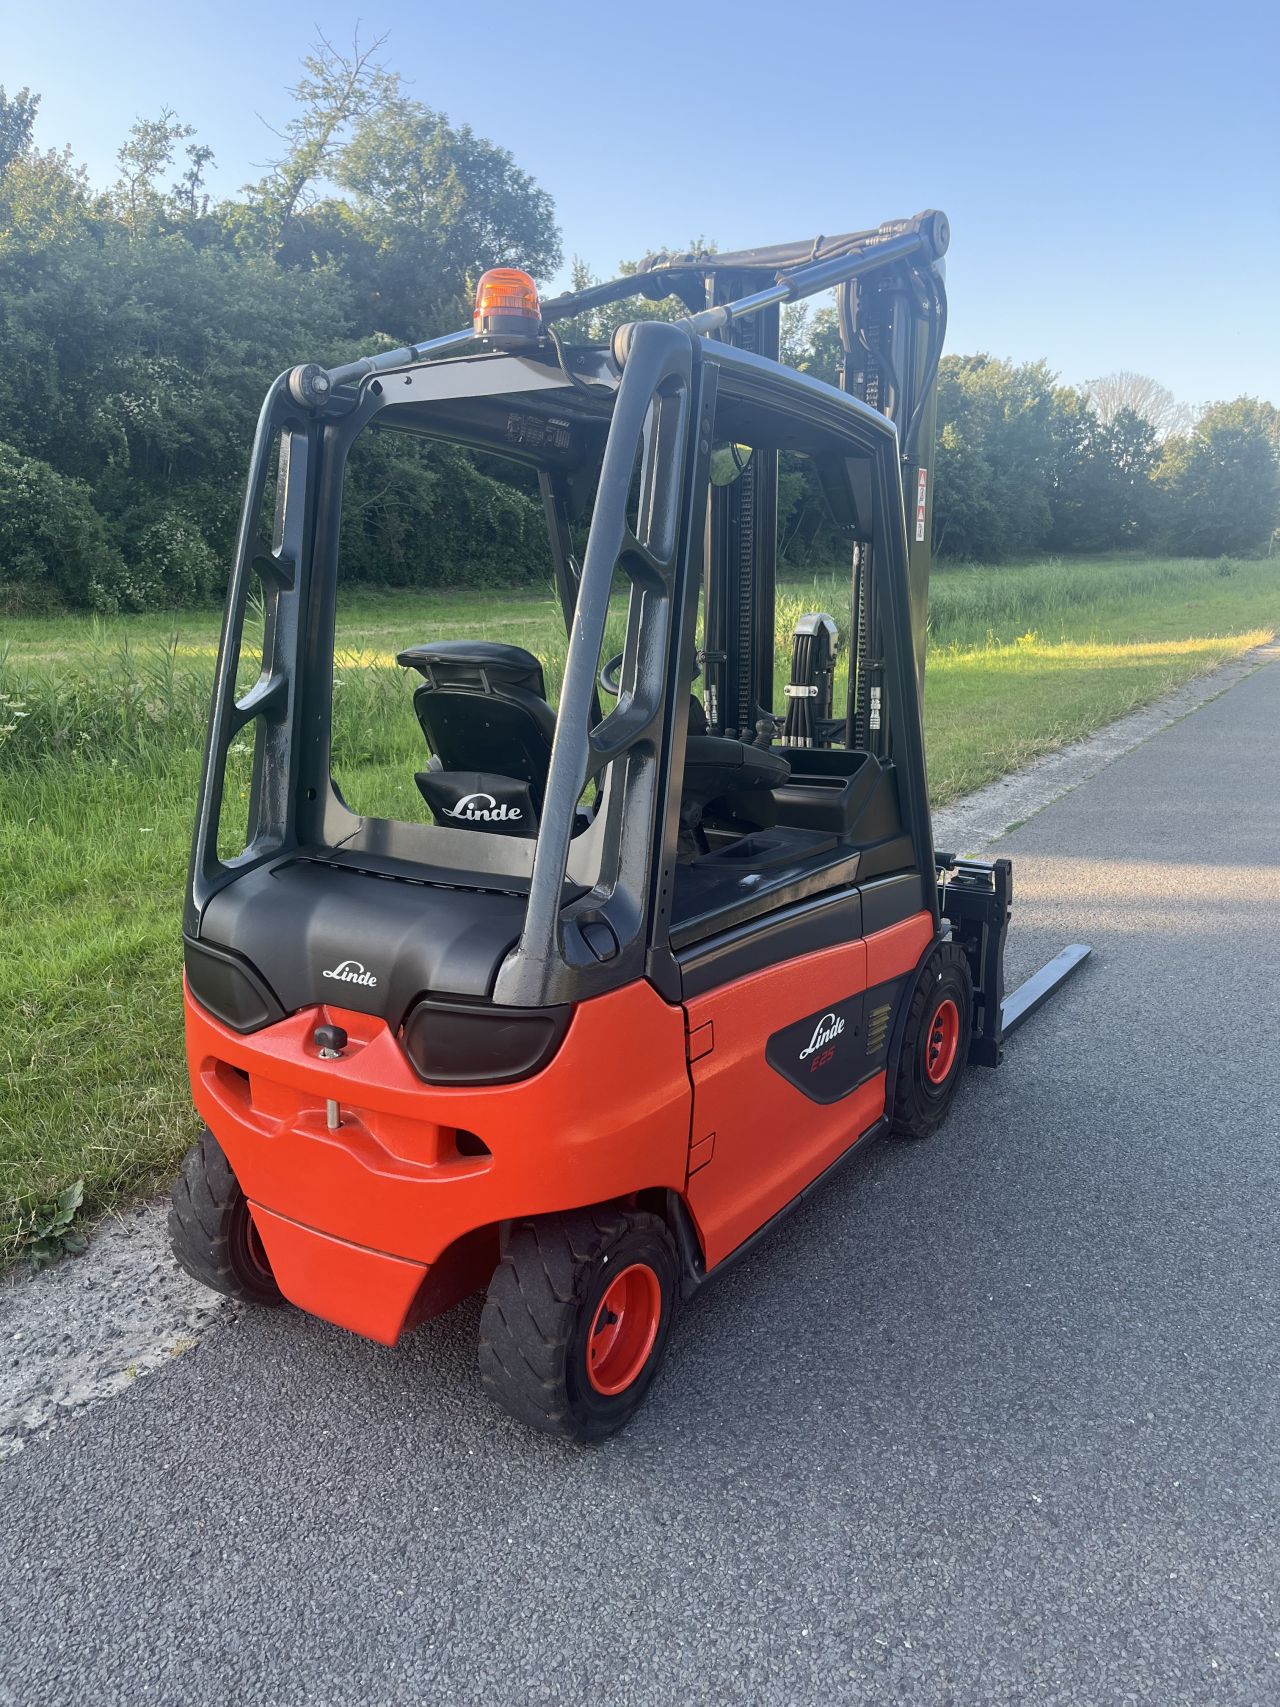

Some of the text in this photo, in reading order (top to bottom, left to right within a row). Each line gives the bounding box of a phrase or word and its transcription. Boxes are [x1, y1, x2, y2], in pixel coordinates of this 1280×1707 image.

[441, 793, 523, 821] Linde
[322, 960, 377, 987] Linde
[799, 1013, 845, 1060] Linde
